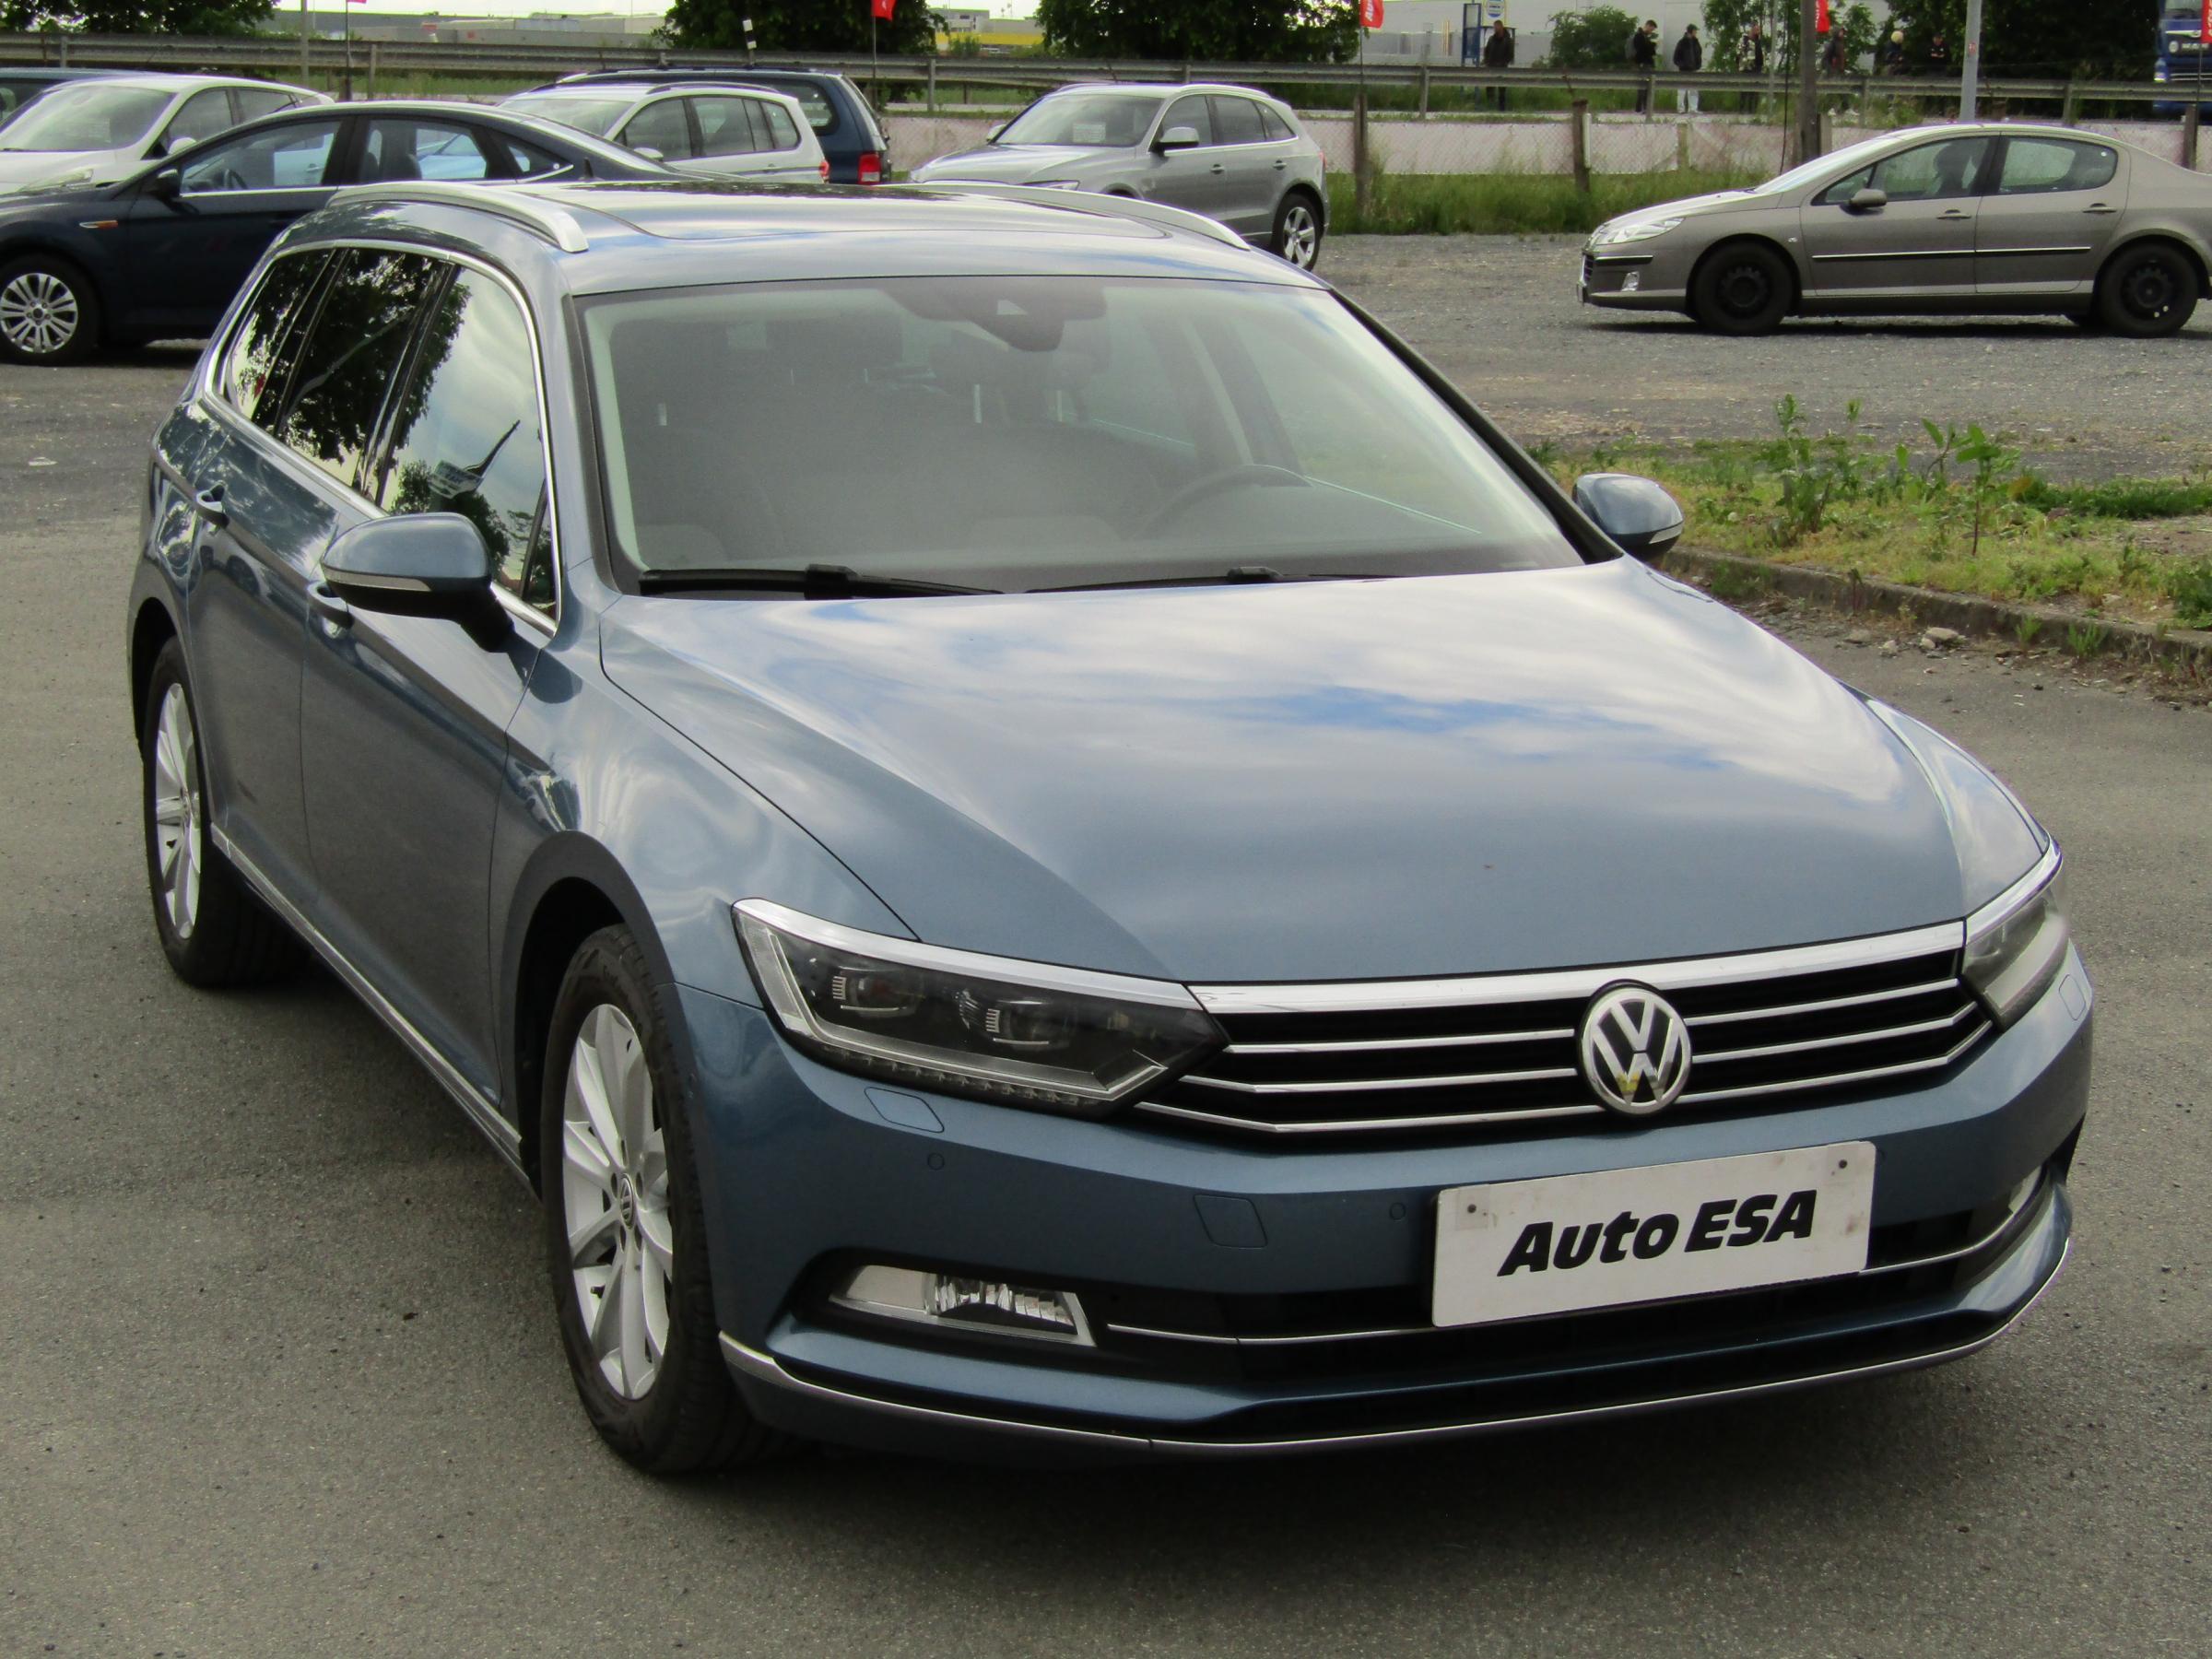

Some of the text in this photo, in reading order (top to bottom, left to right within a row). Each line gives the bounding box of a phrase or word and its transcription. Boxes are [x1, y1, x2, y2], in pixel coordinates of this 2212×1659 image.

[1589, 996, 1685, 1106] VW
[1497, 1189, 1818, 1277] Auto ESA
